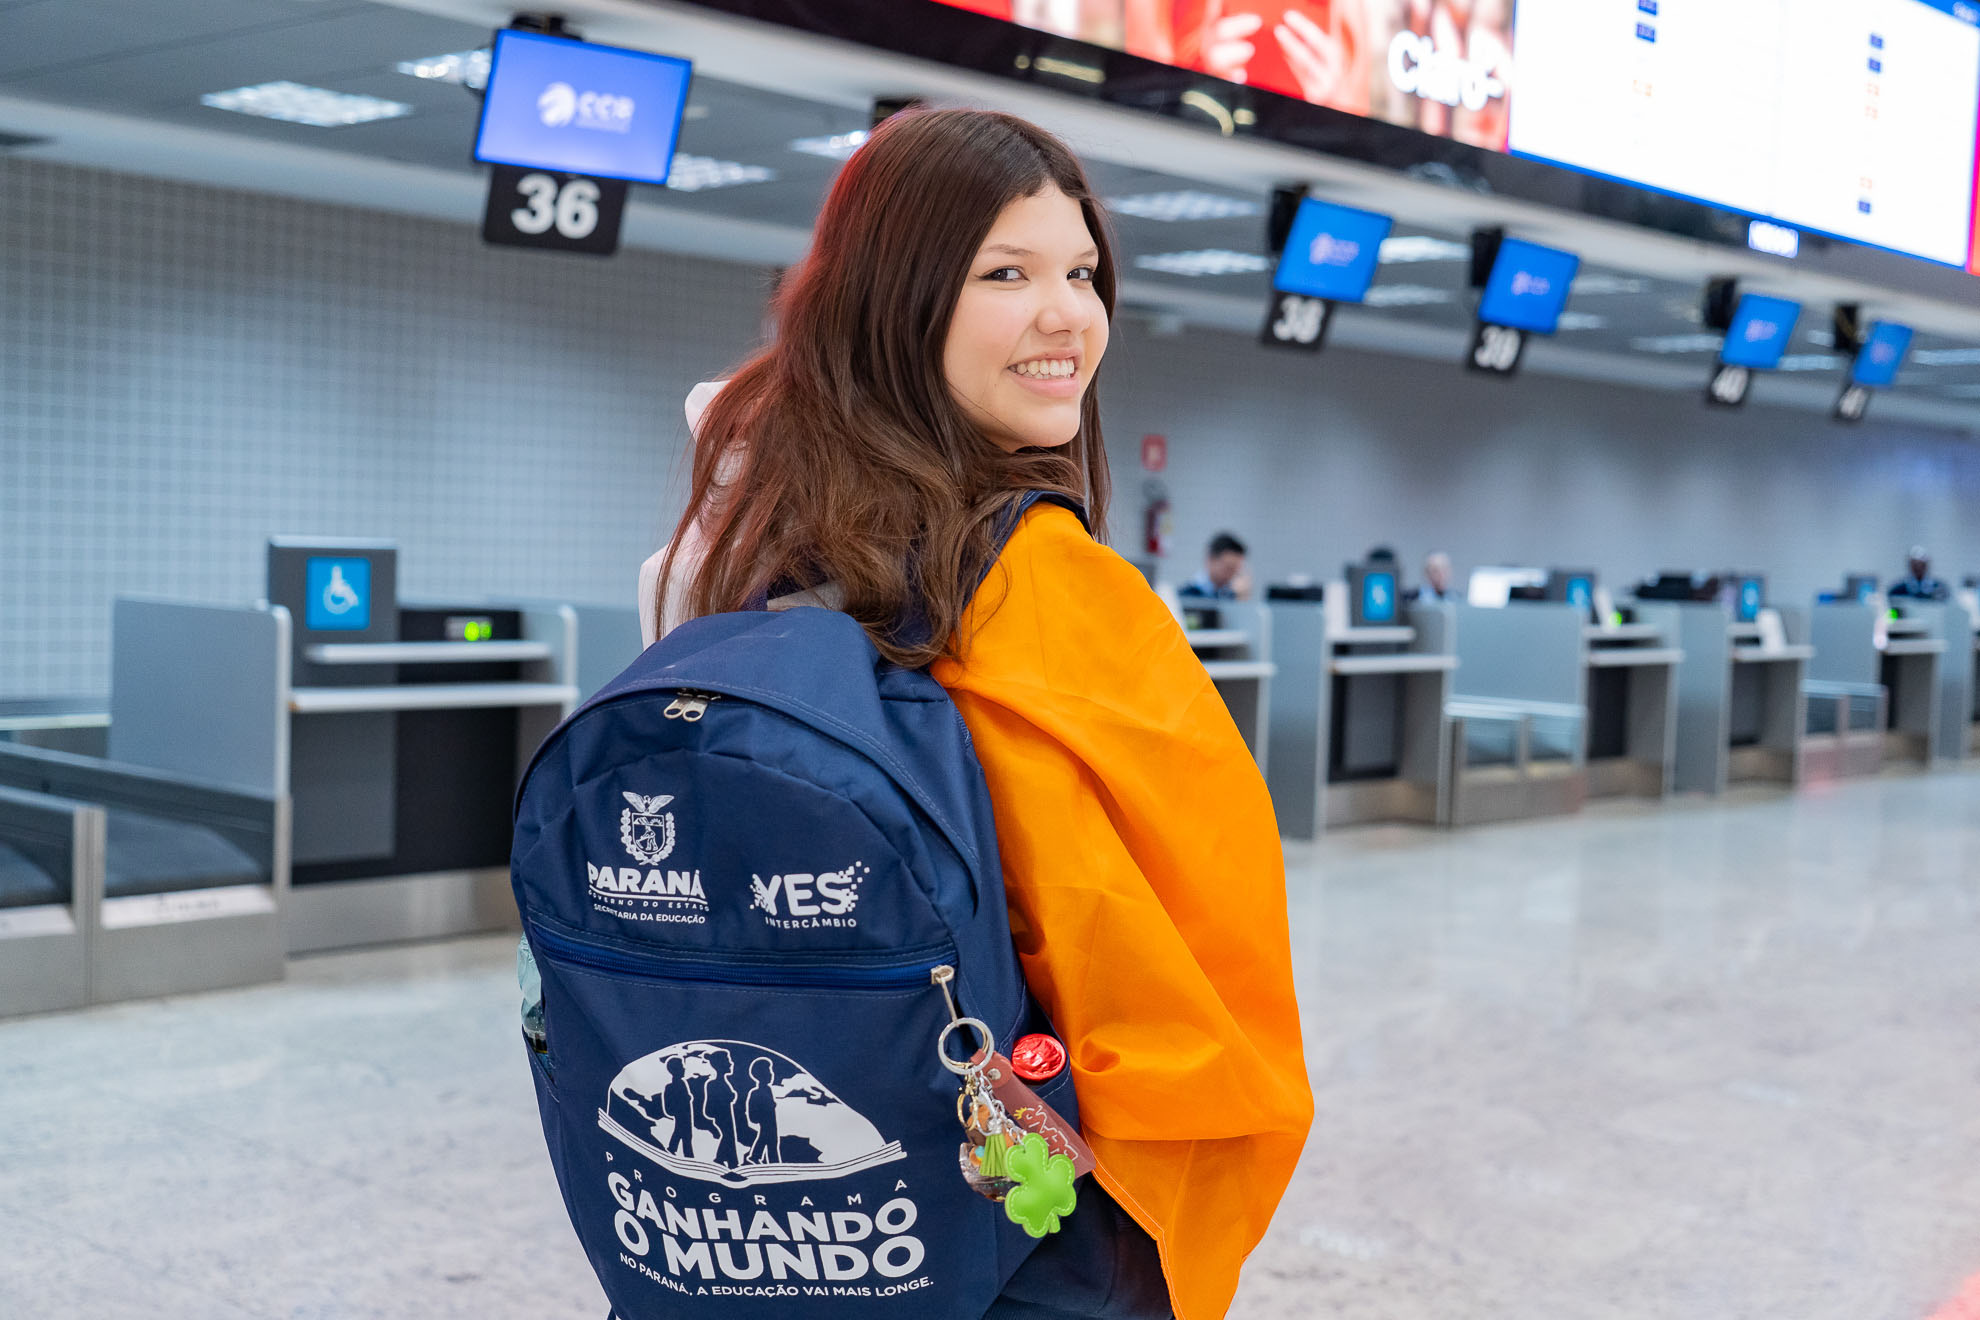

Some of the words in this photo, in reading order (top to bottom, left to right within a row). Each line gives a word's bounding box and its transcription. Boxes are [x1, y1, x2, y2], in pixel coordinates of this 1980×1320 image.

[511, 173, 600, 239] 36
[587, 861, 706, 899] PARANÁ
[588, 889, 633, 906] GOVERNO
[668, 902, 710, 912] ESTADO
[750, 868, 858, 916] YES
[593, 903, 638, 920] SECRETARIA
[640, 912, 654, 921] DA
[656, 913, 706, 924] EDUCAÇÃO
[765, 916, 857, 929] INTERCÂMBIO
[605, 1151, 908, 1206] PROGRAMA
[607, 1171, 918, 1242] GANHANDO
[614, 1209, 650, 1256] O
[662, 1233, 926, 1281] MUNDO
[620, 1252, 637, 1269] NO
[697, 1285, 708, 1296] A
[711, 1284, 799, 1298] EDUCAÇÃO
[802, 1286, 829, 1296] VAI
[833, 1286, 872, 1296] MAIS
[875, 1276, 934, 1297] LONGE.
